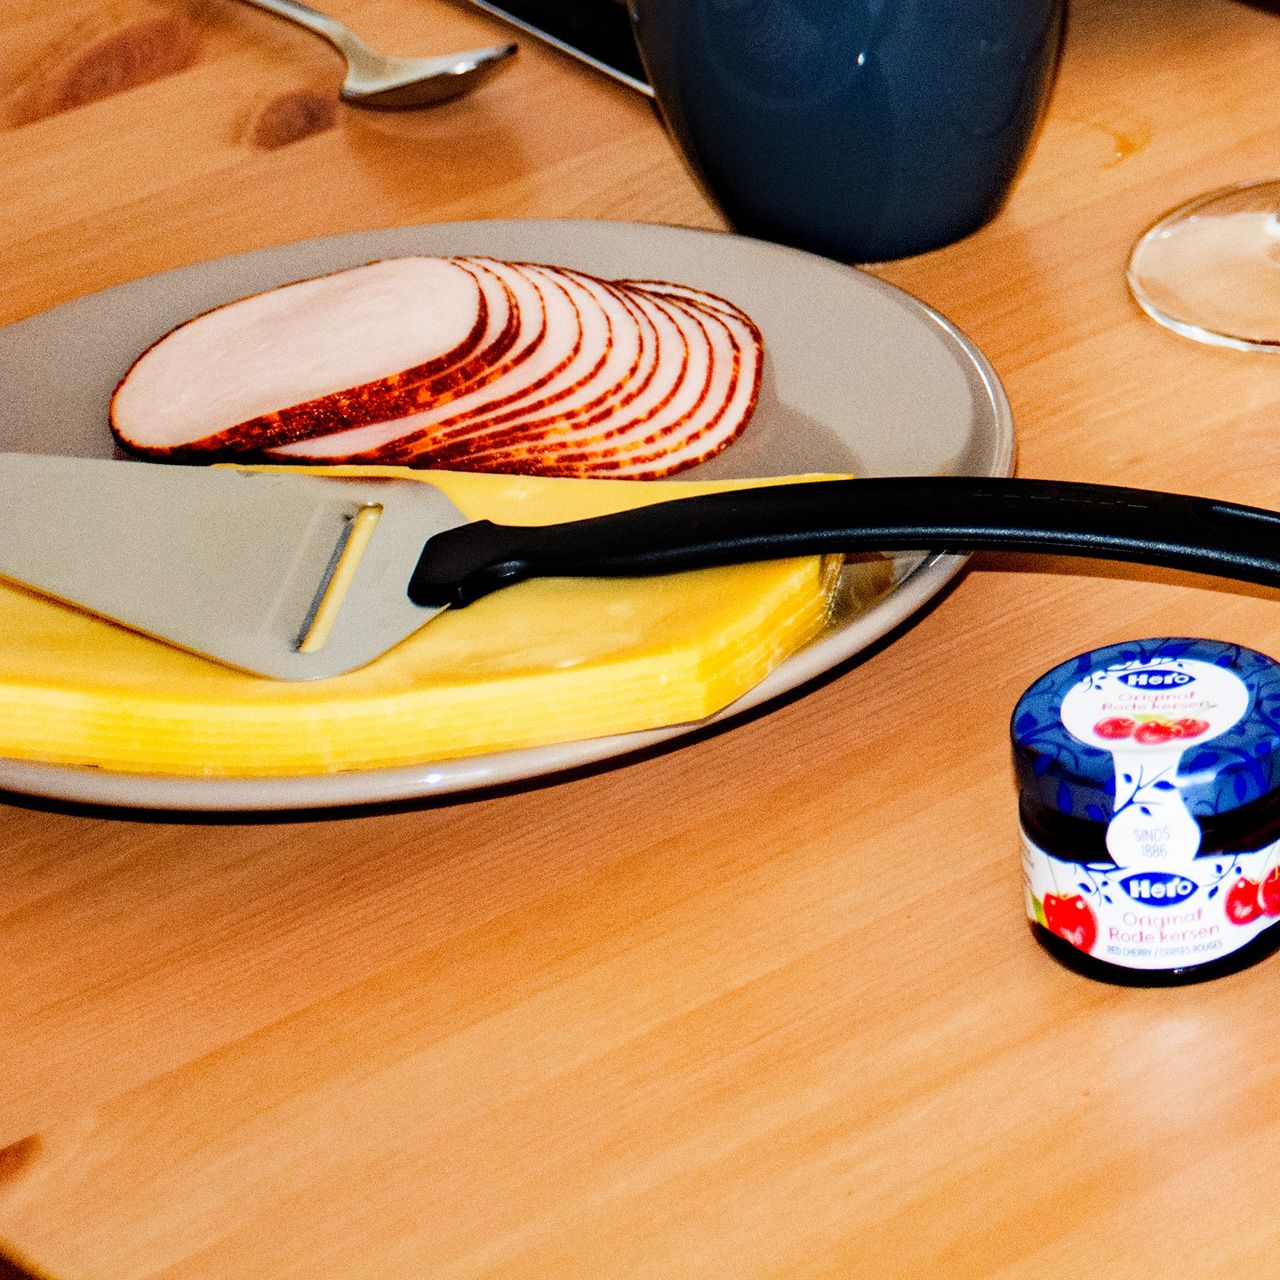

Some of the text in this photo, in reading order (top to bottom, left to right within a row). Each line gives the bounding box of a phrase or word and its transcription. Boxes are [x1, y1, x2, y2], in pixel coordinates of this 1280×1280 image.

[1127, 672, 1190, 686] Hero
[1118, 691, 1196, 703] Original
[1134, 826, 1170, 842] SINDS
[1141, 844, 1168, 858] 1886
[1129, 877, 1192, 898] Hero
[1122, 908, 1203, 928] Original
[1108, 924, 1220, 943] Rode kersen
